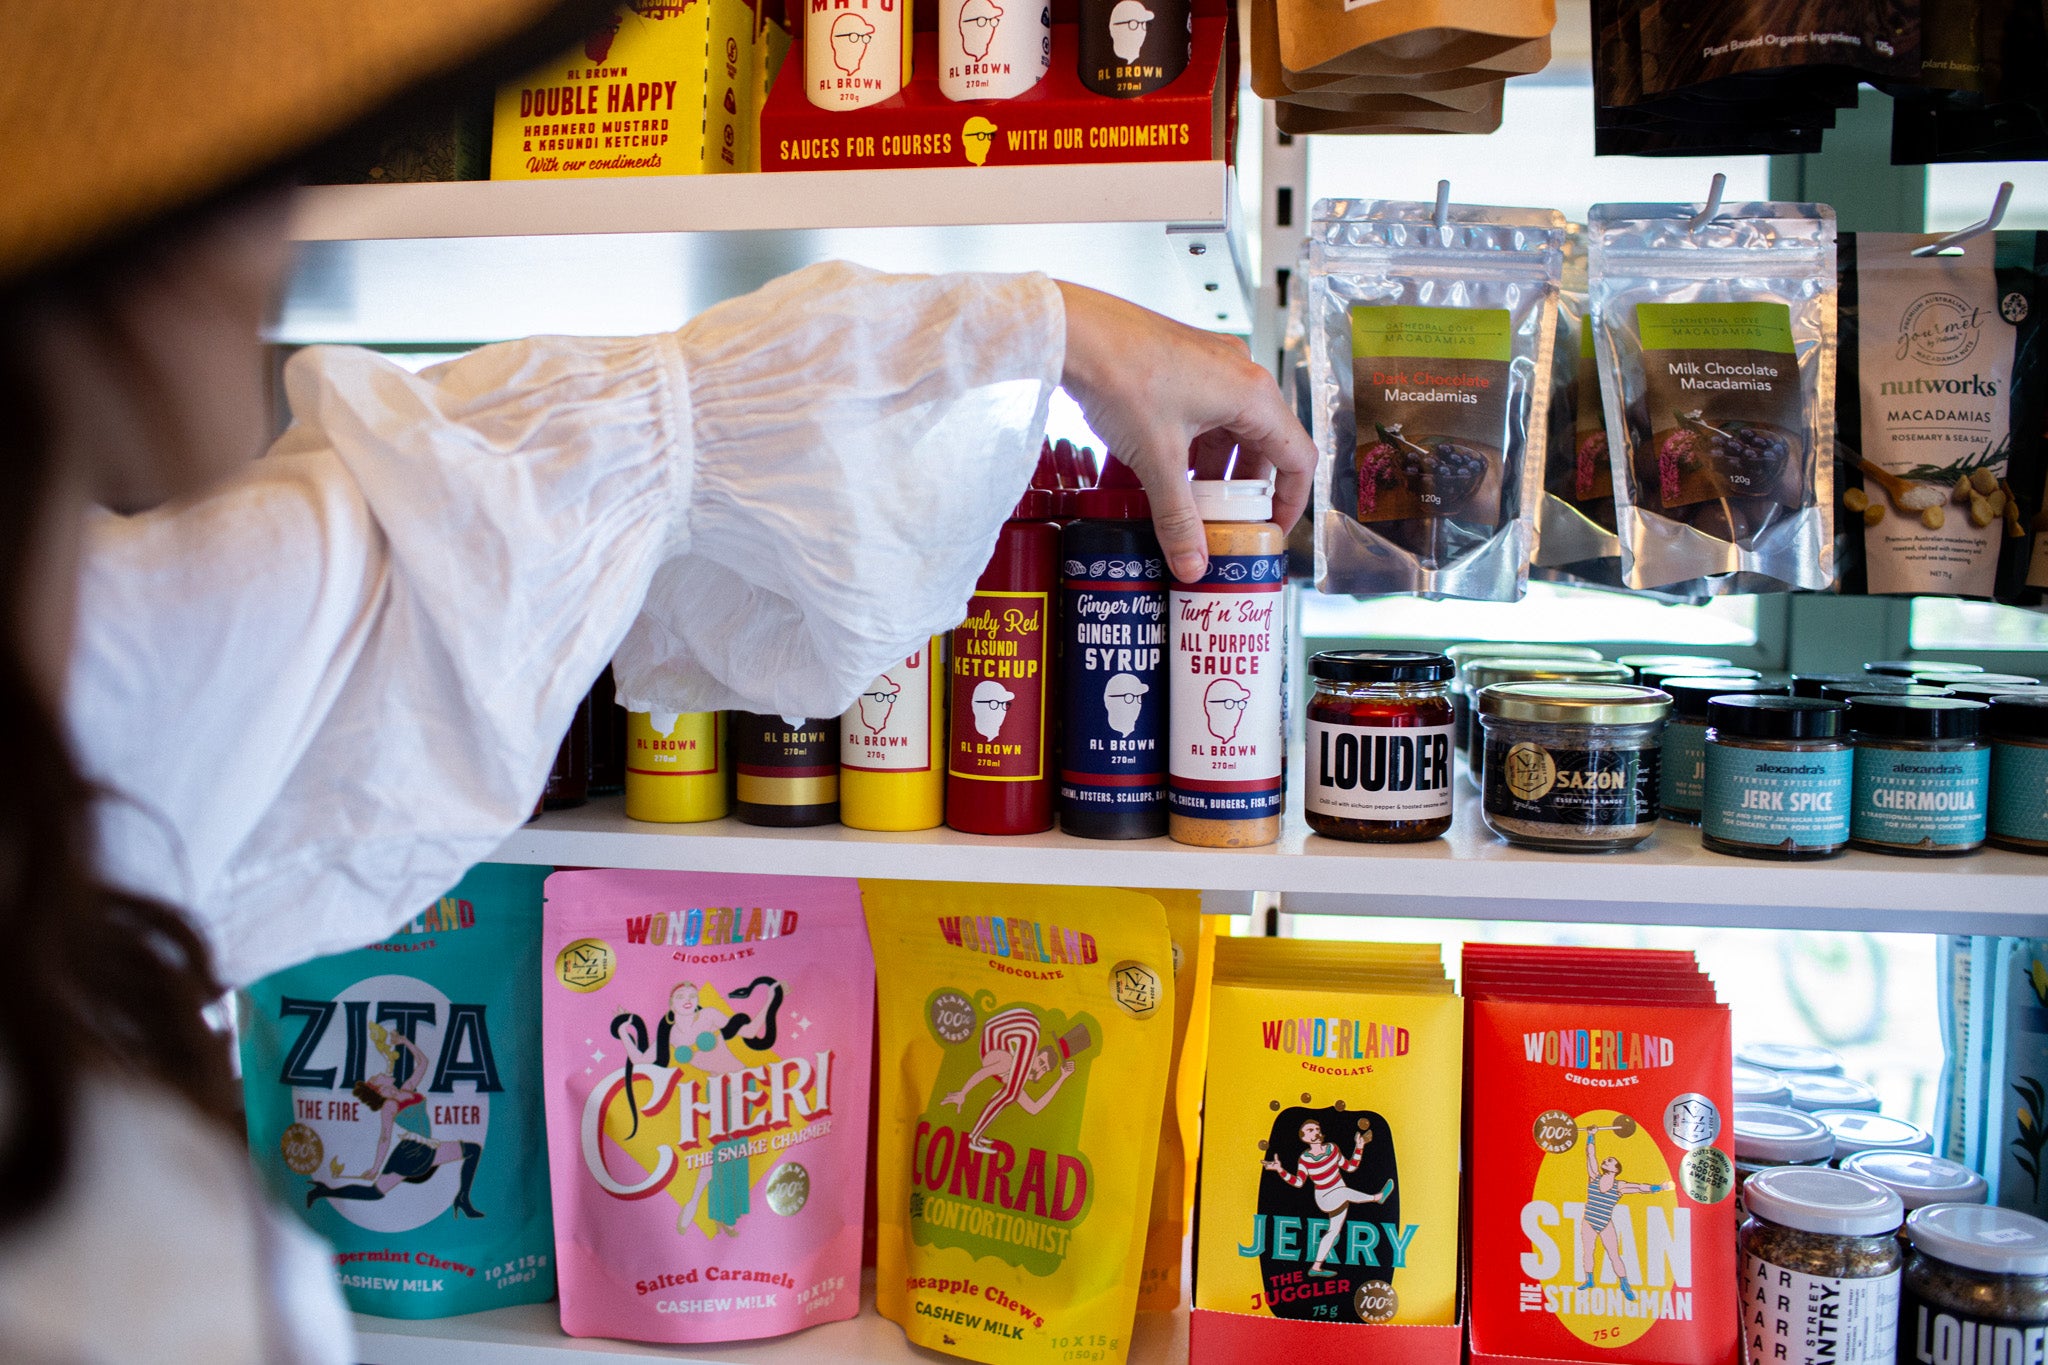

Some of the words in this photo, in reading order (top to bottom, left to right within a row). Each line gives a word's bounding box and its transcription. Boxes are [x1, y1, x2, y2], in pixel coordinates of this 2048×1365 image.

[1703, 42, 1728, 58] Plant
[1730, 34, 1763, 51] Based
[1764, 31, 1808, 48] Organic
[1810, 31, 1861, 46] Ingredients
[567, 69, 582, 80] AL
[585, 66, 628, 79] BROWN
[949, 66, 961, 79] AL
[964, 63, 1011, 76] BROWN
[1098, 67, 1111, 81] AL
[1115, 65, 1163, 79] BROWN
[820, 78, 833, 91] AL
[835, 77, 883, 90] BROWN
[965, 79, 990, 89] 270ml
[1117, 82, 1142, 92] 270ml
[520, 84, 599, 118] DOUBLE
[606, 80, 678, 114] HAPPY
[839, 92, 860, 103] 270g
[523, 121, 596, 138] HABANERO
[602, 118, 669, 134] MUSTARD
[523, 140, 533, 153] &
[539, 136, 599, 152] KASUNDI
[604, 133, 669, 149] KETCHUP
[780, 137, 840, 161] SAUCES
[846, 136, 876, 158] FOR
[882, 132, 953, 156] COURSES
[1007, 129, 1048, 151] WITH
[1053, 127, 1084, 149] OUR
[1089, 123, 1190, 148] CONDIMENTS
[526, 156, 560, 174] With
[562, 158, 587, 172] our
[588, 152, 662, 171] condiments
[1385, 334, 1476, 345] MACADAMIAS
[1896, 307, 1992, 360] gourmet
[1668, 362, 1701, 376] Milk
[1704, 362, 1778, 377] Chocolate
[1373, 371, 1408, 386] Dark
[1413, 371, 1489, 389] Chocolate
[1680, 377, 1772, 391] Macadamias
[1880, 374, 1997, 397] nutworks
[1384, 388, 1478, 404] Macadamias
[1887, 409, 1991, 423] MACADAMIAS
[1892, 434, 1943, 443] ROSEMARY
[1953, 434, 1969, 443] SEA
[1970, 435, 1989, 444] SALT
[1729, 474, 1750, 486] 120g
[1420, 493, 1442, 505] 120g
[1077, 594, 1130, 621] Ginger
[1003, 608, 1039, 635] Red
[1077, 623, 1131, 645] GINGER
[1137, 624, 1166, 645] LIME
[1180, 632, 1202, 652] ALL
[1209, 633, 1270, 653] PURPOSE
[967, 639, 1018, 657] KASUNDI
[955, 656, 1038, 678] KETCHUP
[1085, 648, 1160, 671] SYRUP
[1191, 656, 1259, 675] SAUCE
[637, 739, 650, 750] AL
[653, 739, 696, 750] BROWN
[764, 732, 778, 743] AL
[781, 731, 826, 743] BROWN
[849, 734, 861, 746] AL
[865, 736, 908, 747] BROWN
[1090, 739, 1104, 750] AL
[1110, 739, 1155, 751] BROWN
[783, 747, 807, 757] 270ml
[867, 751, 886, 761] 270g
[961, 741, 974, 753] AL
[977, 743, 1022, 755] BROWN
[1191, 744, 1204, 756] AL
[1210, 744, 1257, 757] BROWN
[654, 754, 677, 764] 270ml
[977, 758, 1000, 767] 270ml
[1111, 756, 1136, 764] 270ml
[1212, 761, 1237, 770] 270ml
[1320, 730, 1449, 792] LOUDER
[1755, 763, 1826, 775] alexandra's
[1892, 763, 1963, 775] alexandra's
[1556, 767, 1626, 790] SAZÓN
[1080, 791, 1114, 804] OYSTERS,
[1117, 792, 1155, 803] SCALLOPS,
[1178, 795, 1207, 809] CHICKEN,
[1210, 799, 1248, 810] BURGERS,
[1251, 797, 1268, 809] FISH,
[1556, 797, 1598, 805] ESSENTIALS
[1600, 797, 1624, 805] RANGE
[1740, 789, 1784, 811] JERK
[1789, 791, 1834, 812] SPICE
[1872, 788, 1975, 811] CHERMOULA
[626, 907, 798, 946] WONDERLAND
[938, 916, 1098, 965] WONDERLAND
[672, 948, 755, 964] CHOCOLATE
[989, 960, 1064, 981] CHOCOLATE
[937, 993, 971, 1013] PLANT
[937, 1010, 970, 1028] 100%
[938, 1026, 970, 1042] BASED
[1262, 1017, 1410, 1060] WONDERLAND
[279, 995, 505, 1093] ZITA
[1523, 1029, 1674, 1070] WONDERLAND
[1301, 1061, 1374, 1076] CHOCOLATE
[1565, 1073, 1640, 1088] CHOCOLATE
[297, 1099, 323, 1120] THE
[328, 1101, 360, 1122] FIRE
[434, 1105, 481, 1125] EATER
[1540, 1112, 1573, 1127] PLANT
[580, 1050, 836, 1201] CHERI
[1539, 1125, 1572, 1139] 100%
[684, 1149, 714, 1171] THE
[717, 1138, 768, 1163] SNAKE
[771, 1120, 833, 1150] CHARMER
[1541, 1138, 1573, 1154] BASED
[913, 1121, 1088, 1222] CONRAD
[1687, 1161, 1728, 1185] PRODUCER
[1698, 1159, 1721, 1174] FOOD
[1689, 1171, 1721, 1189] AWARDS
[1690, 1190, 1708, 1201] GOLD
[923, 1196, 1069, 1256] CONTORTIONIST
[1237, 1214, 1420, 1269] JERRY
[1520, 1200, 1692, 1288] STAN
[414, 1251, 477, 1278] Chews
[403, 1279, 444, 1293] M!LK
[635, 1268, 699, 1296] Salted
[705, 1266, 796, 1290] Caramels
[1269, 1271, 1304, 1288] THE
[1361, 1280, 1395, 1296] PLANT
[656, 1297, 732, 1314] CASHEW
[735, 1293, 777, 1310] M!LK
[1251, 1279, 1351, 1312] JUGGLER
[1360, 1295, 1394, 1310] 100%
[1520, 1283, 1542, 1313] THE
[1544, 1284, 1693, 1321] STRONGMAN
[984, 1286, 1045, 1329] Chews
[1806, 1282, 1821, 1347] STREET
[915, 1300, 982, 1329] CASHEW
[983, 1319, 1025, 1341] M!LK
[1916, 1304, 2048, 1365] LOUDE
